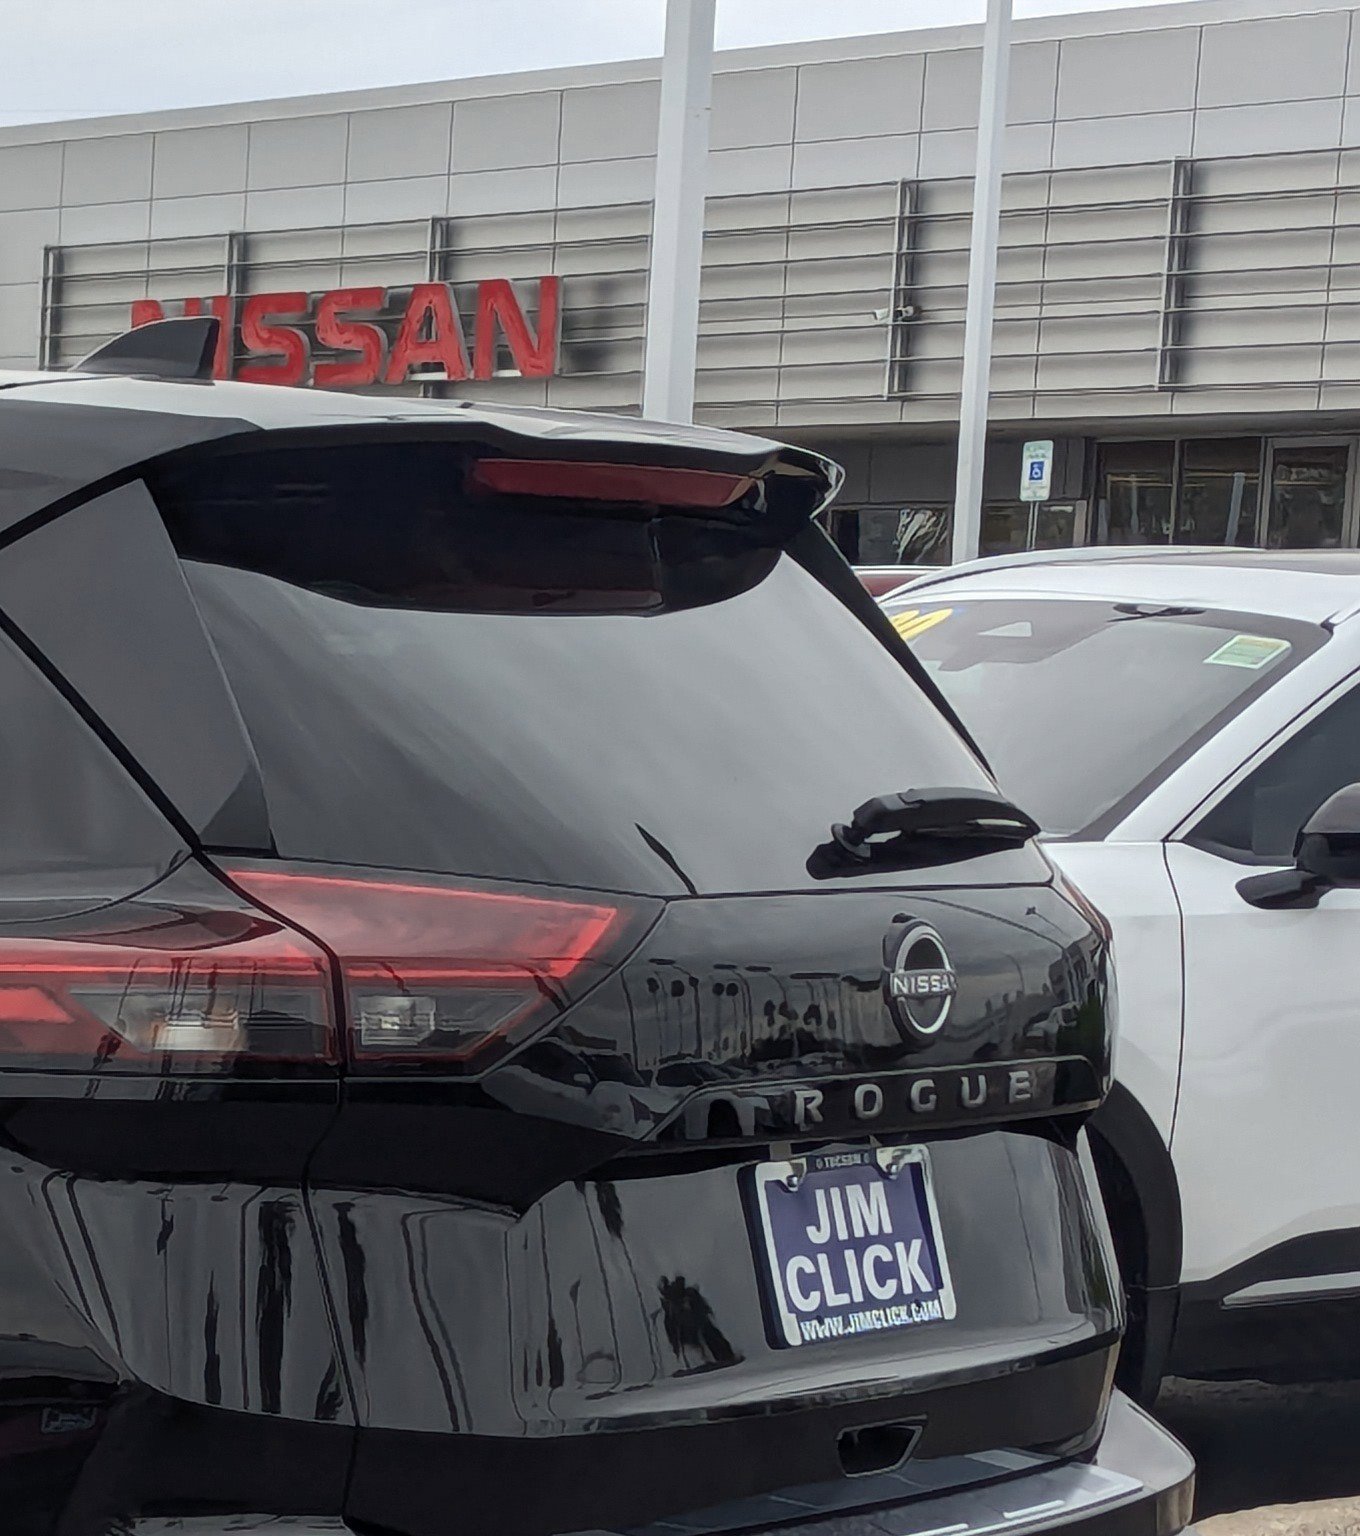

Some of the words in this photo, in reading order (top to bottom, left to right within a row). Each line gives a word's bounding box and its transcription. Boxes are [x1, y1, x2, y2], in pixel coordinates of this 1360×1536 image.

[793, 1070, 1031, 1127] ROGUE
[805, 1181, 893, 1244] JIM
[785, 1238, 933, 1312] CLICK
